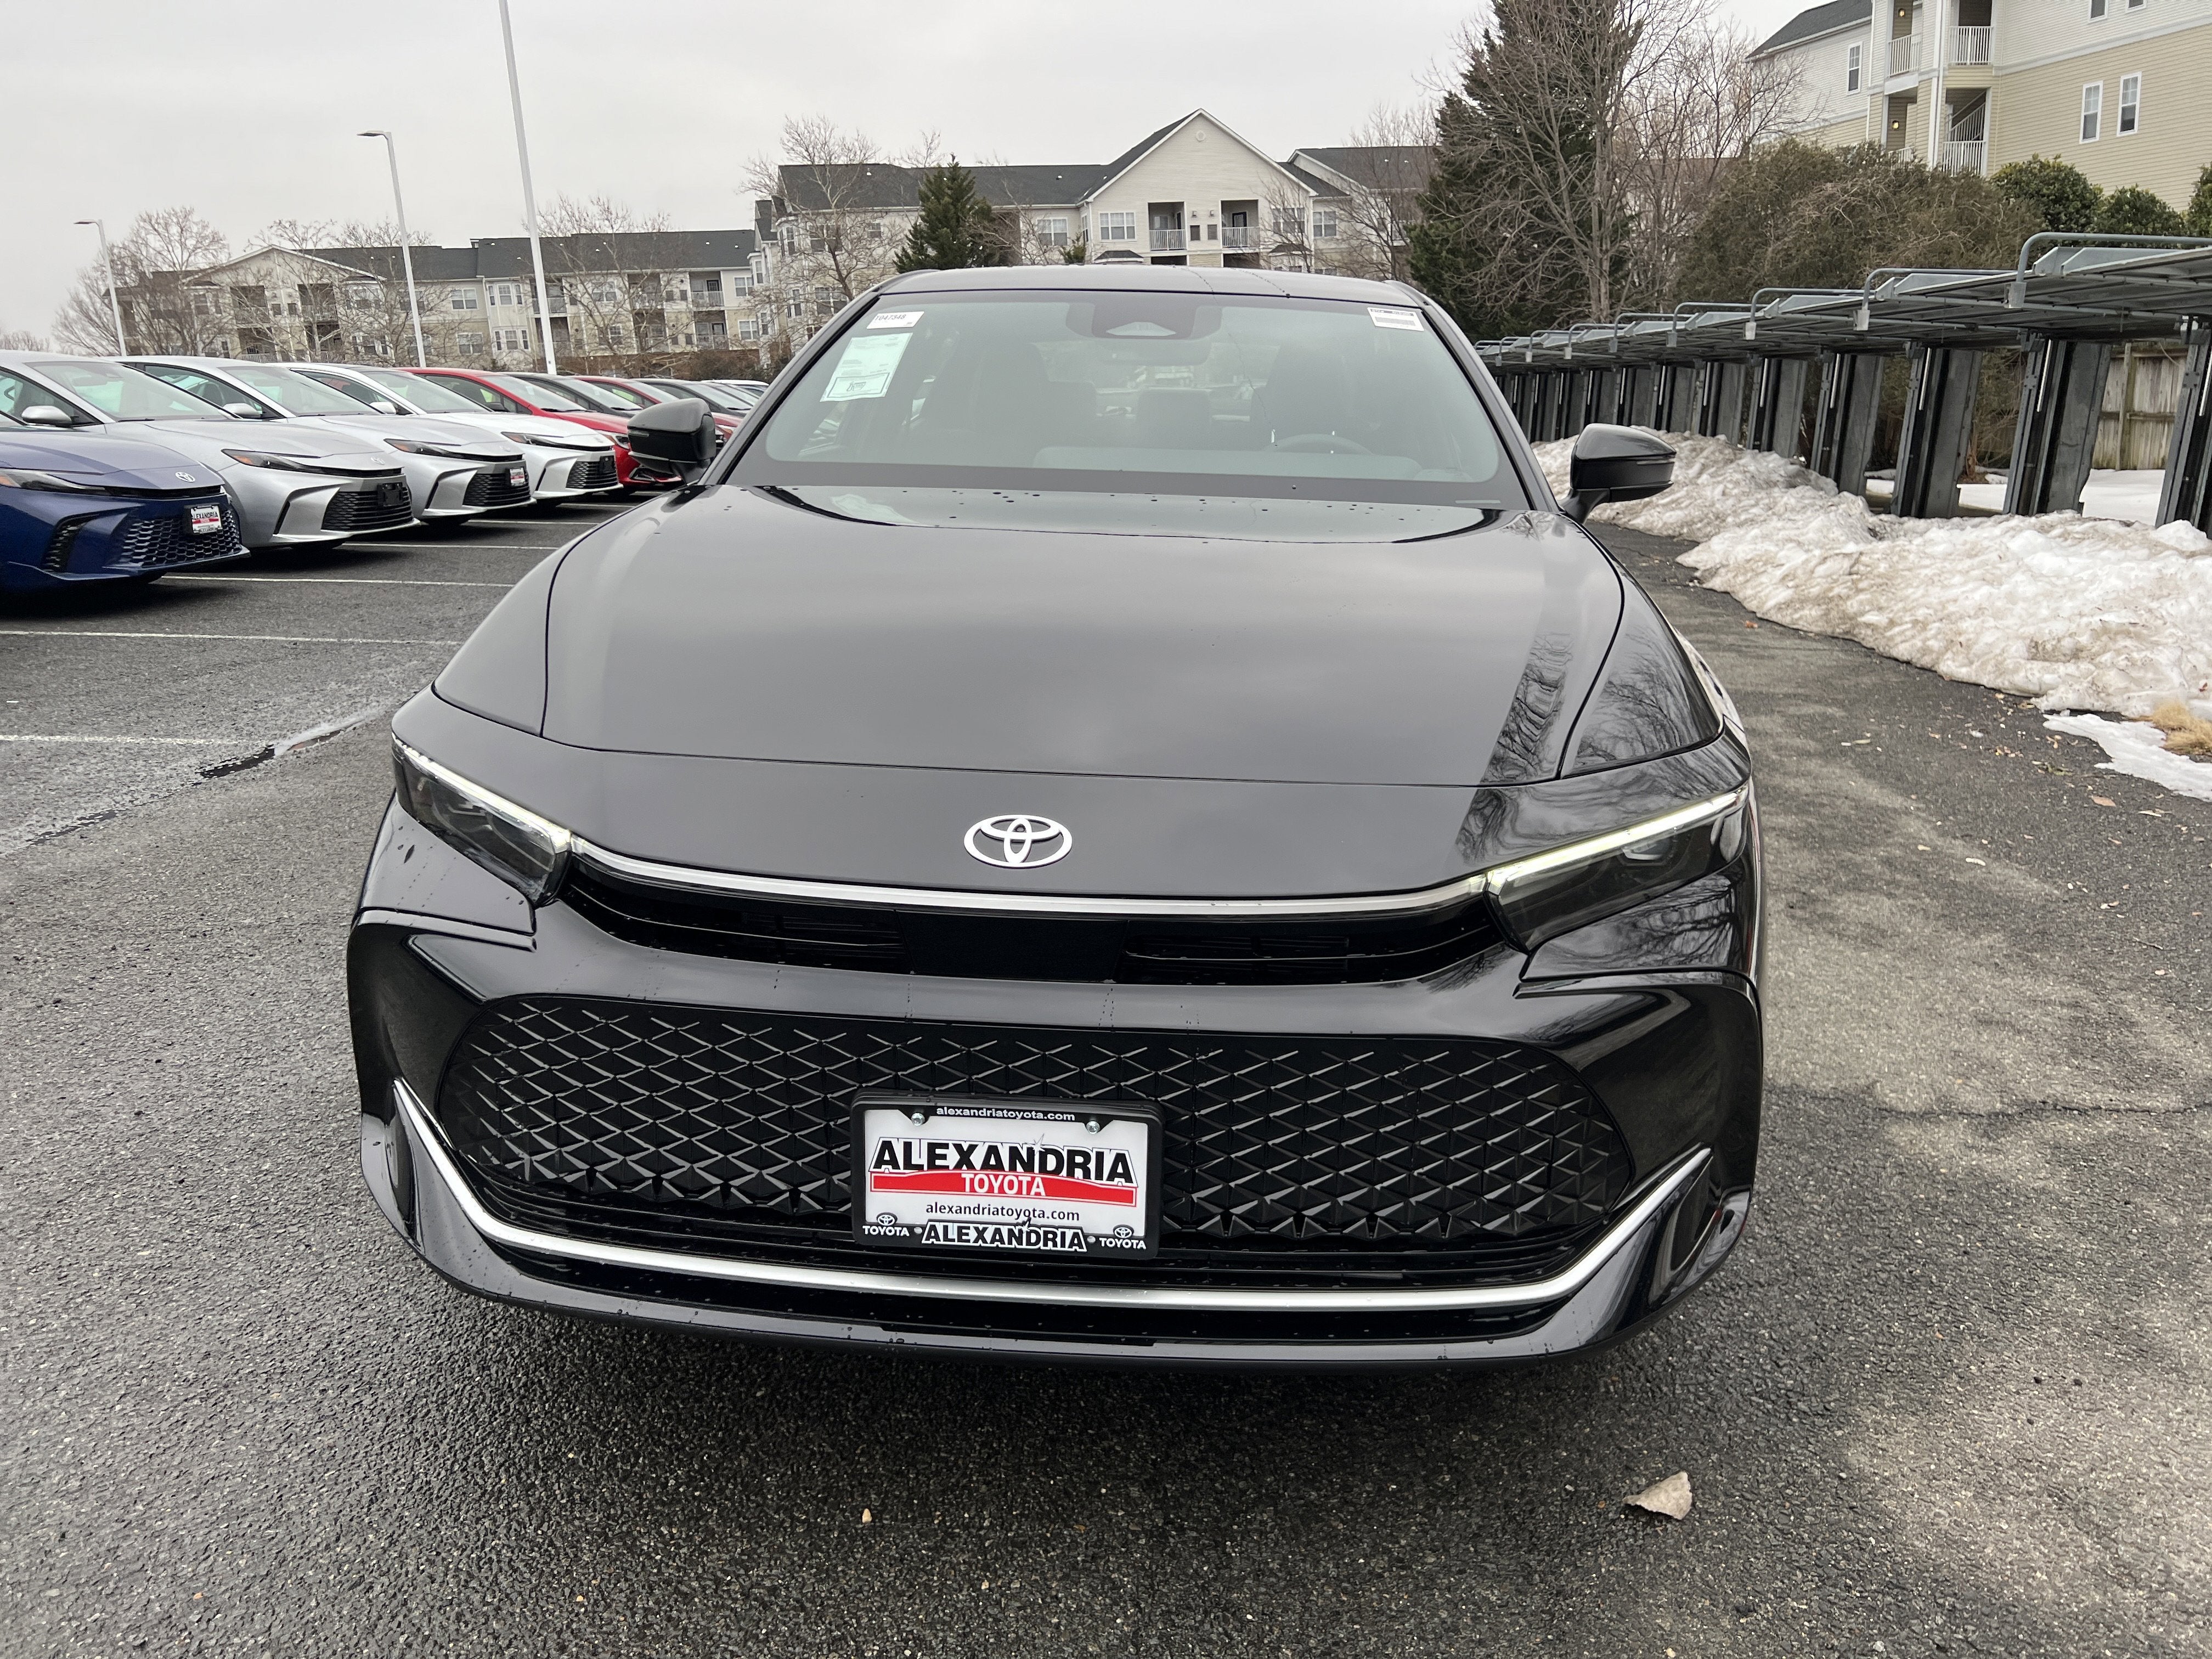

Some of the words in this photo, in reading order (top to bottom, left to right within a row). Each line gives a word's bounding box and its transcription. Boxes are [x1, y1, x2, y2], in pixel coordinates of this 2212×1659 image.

[936, 1107, 1075, 1121] alexandriatoyota.com
[872, 1139, 1135, 1184] ALEXANDRIA
[961, 1173, 1046, 1197] TOYOTA
[926, 1202, 1080, 1221] alexandriatoyota.com
[862, 1225, 910, 1237] TOYOTA
[923, 1223, 1086, 1251] ALEXANDRIA
[1099, 1237, 1147, 1250] TOYOTA
